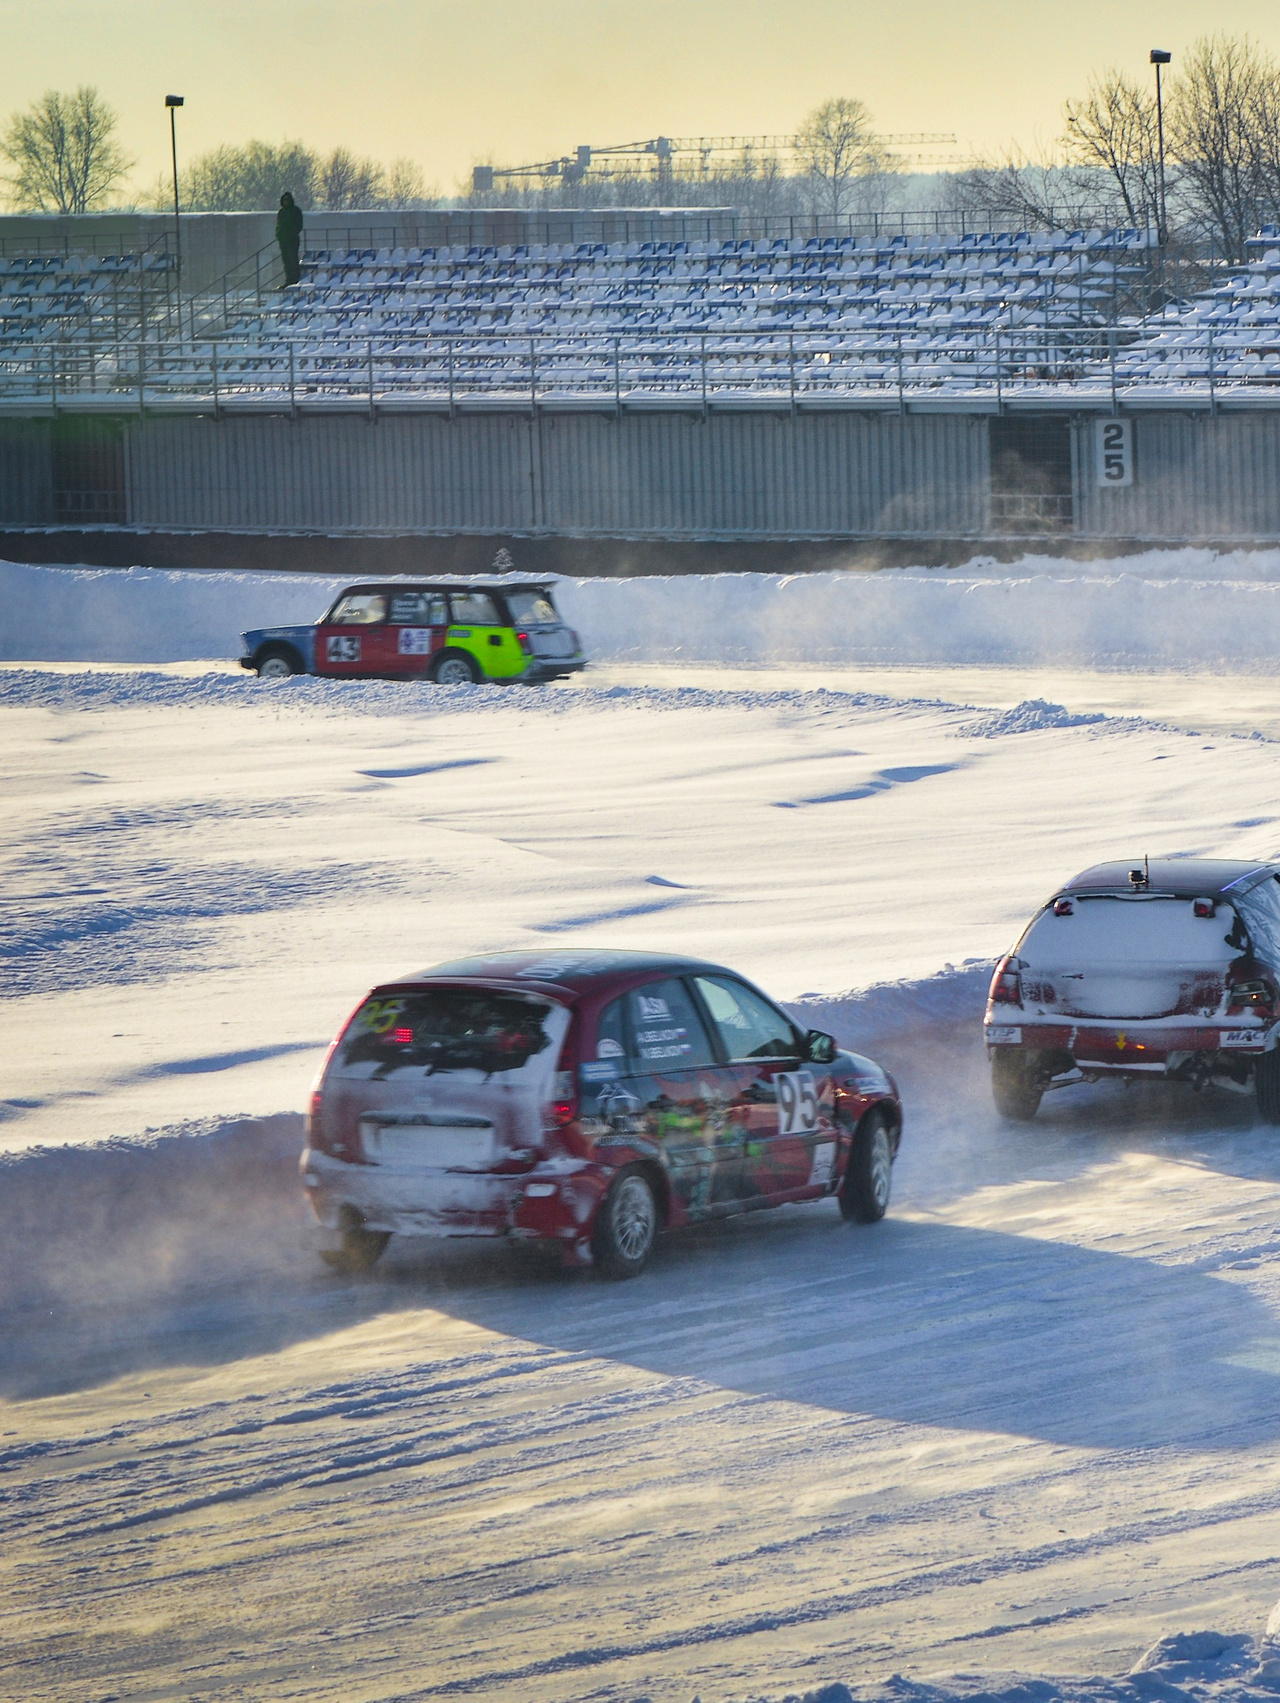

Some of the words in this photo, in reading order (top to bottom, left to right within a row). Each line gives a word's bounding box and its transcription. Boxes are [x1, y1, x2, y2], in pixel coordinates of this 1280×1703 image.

[1103, 423, 1124, 480] 25
[328, 638, 357, 660] 43
[359, 1000, 400, 1034] 95
[777, 1073, 816, 1132] 95
